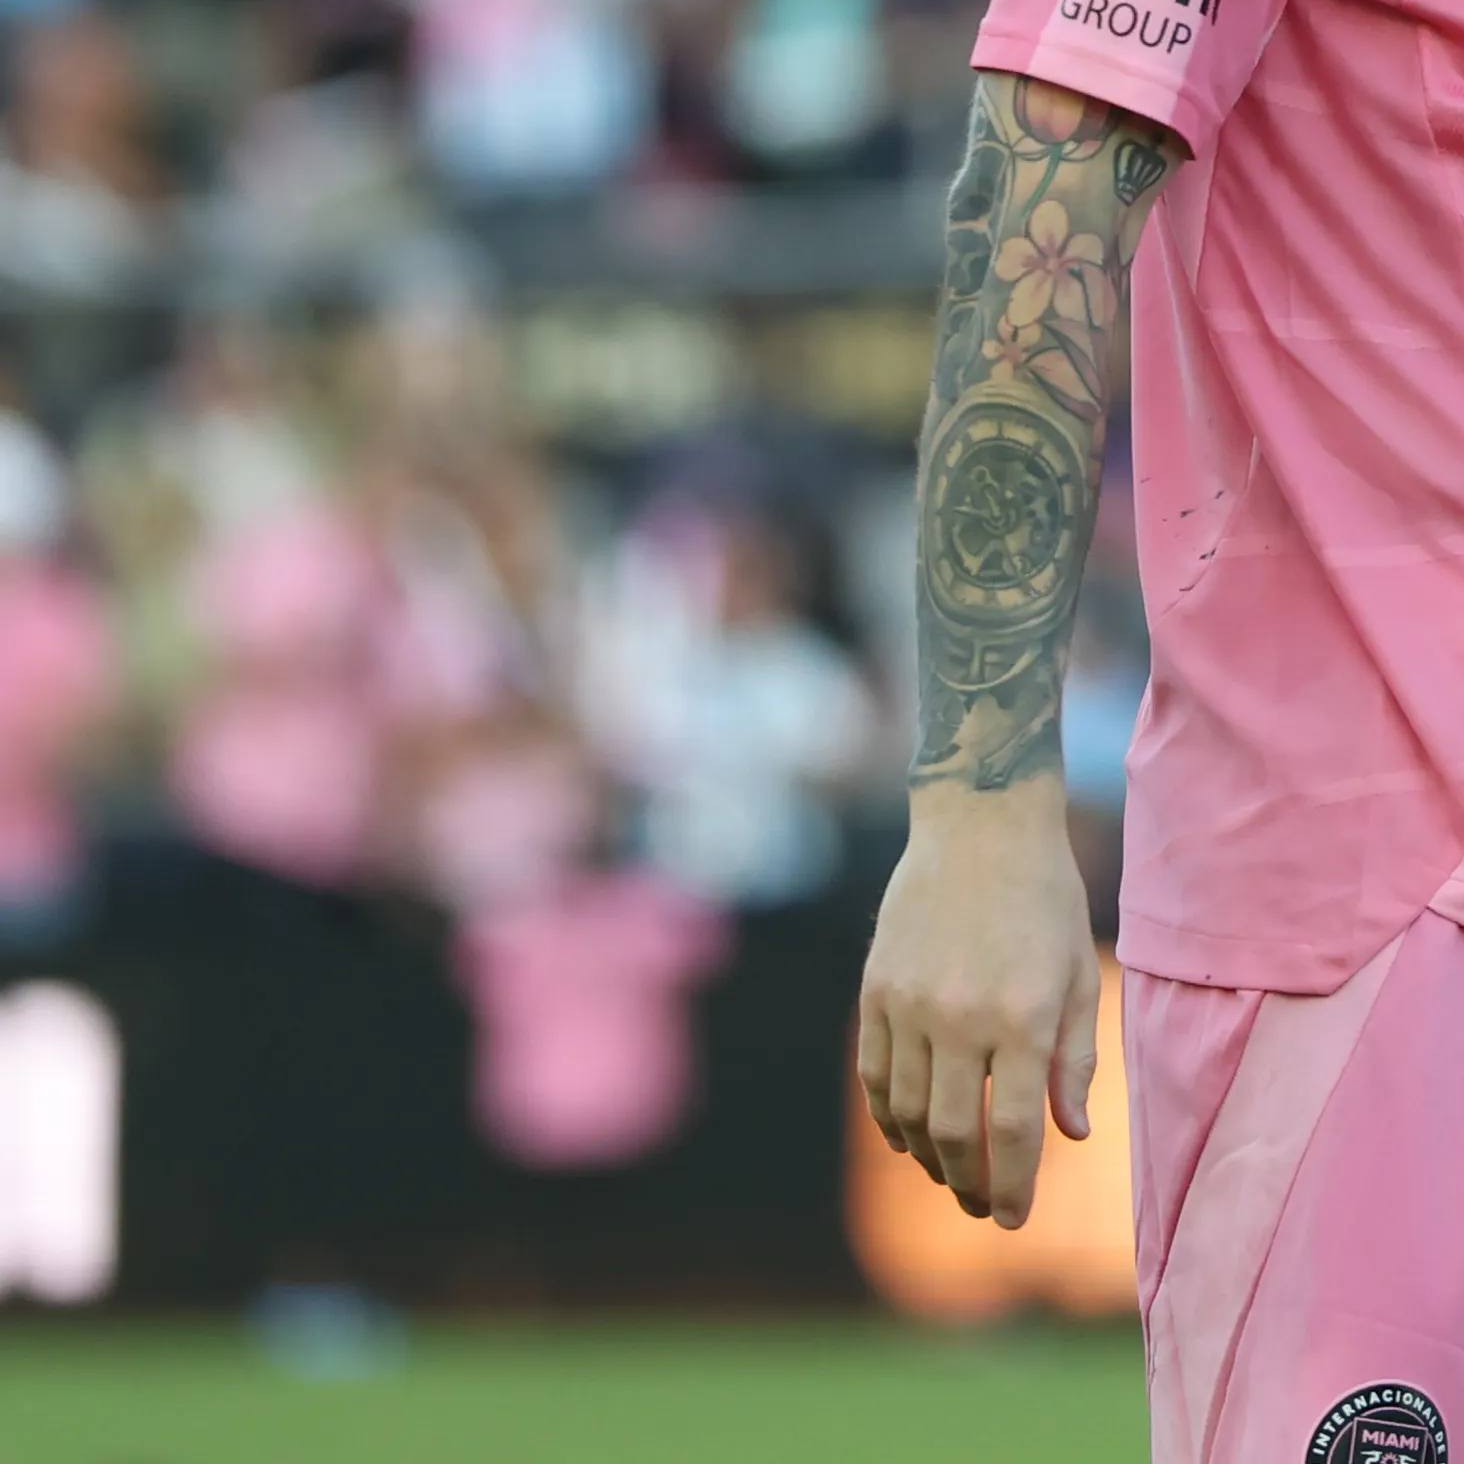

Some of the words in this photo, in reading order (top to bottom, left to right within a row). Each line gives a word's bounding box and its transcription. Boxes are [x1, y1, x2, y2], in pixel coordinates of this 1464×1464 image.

[1312, 1388, 1437, 1456] INTERNACIONAL
[1434, 1430, 1446, 1455] DE
[1361, 1429, 1420, 1452] MIAMI
